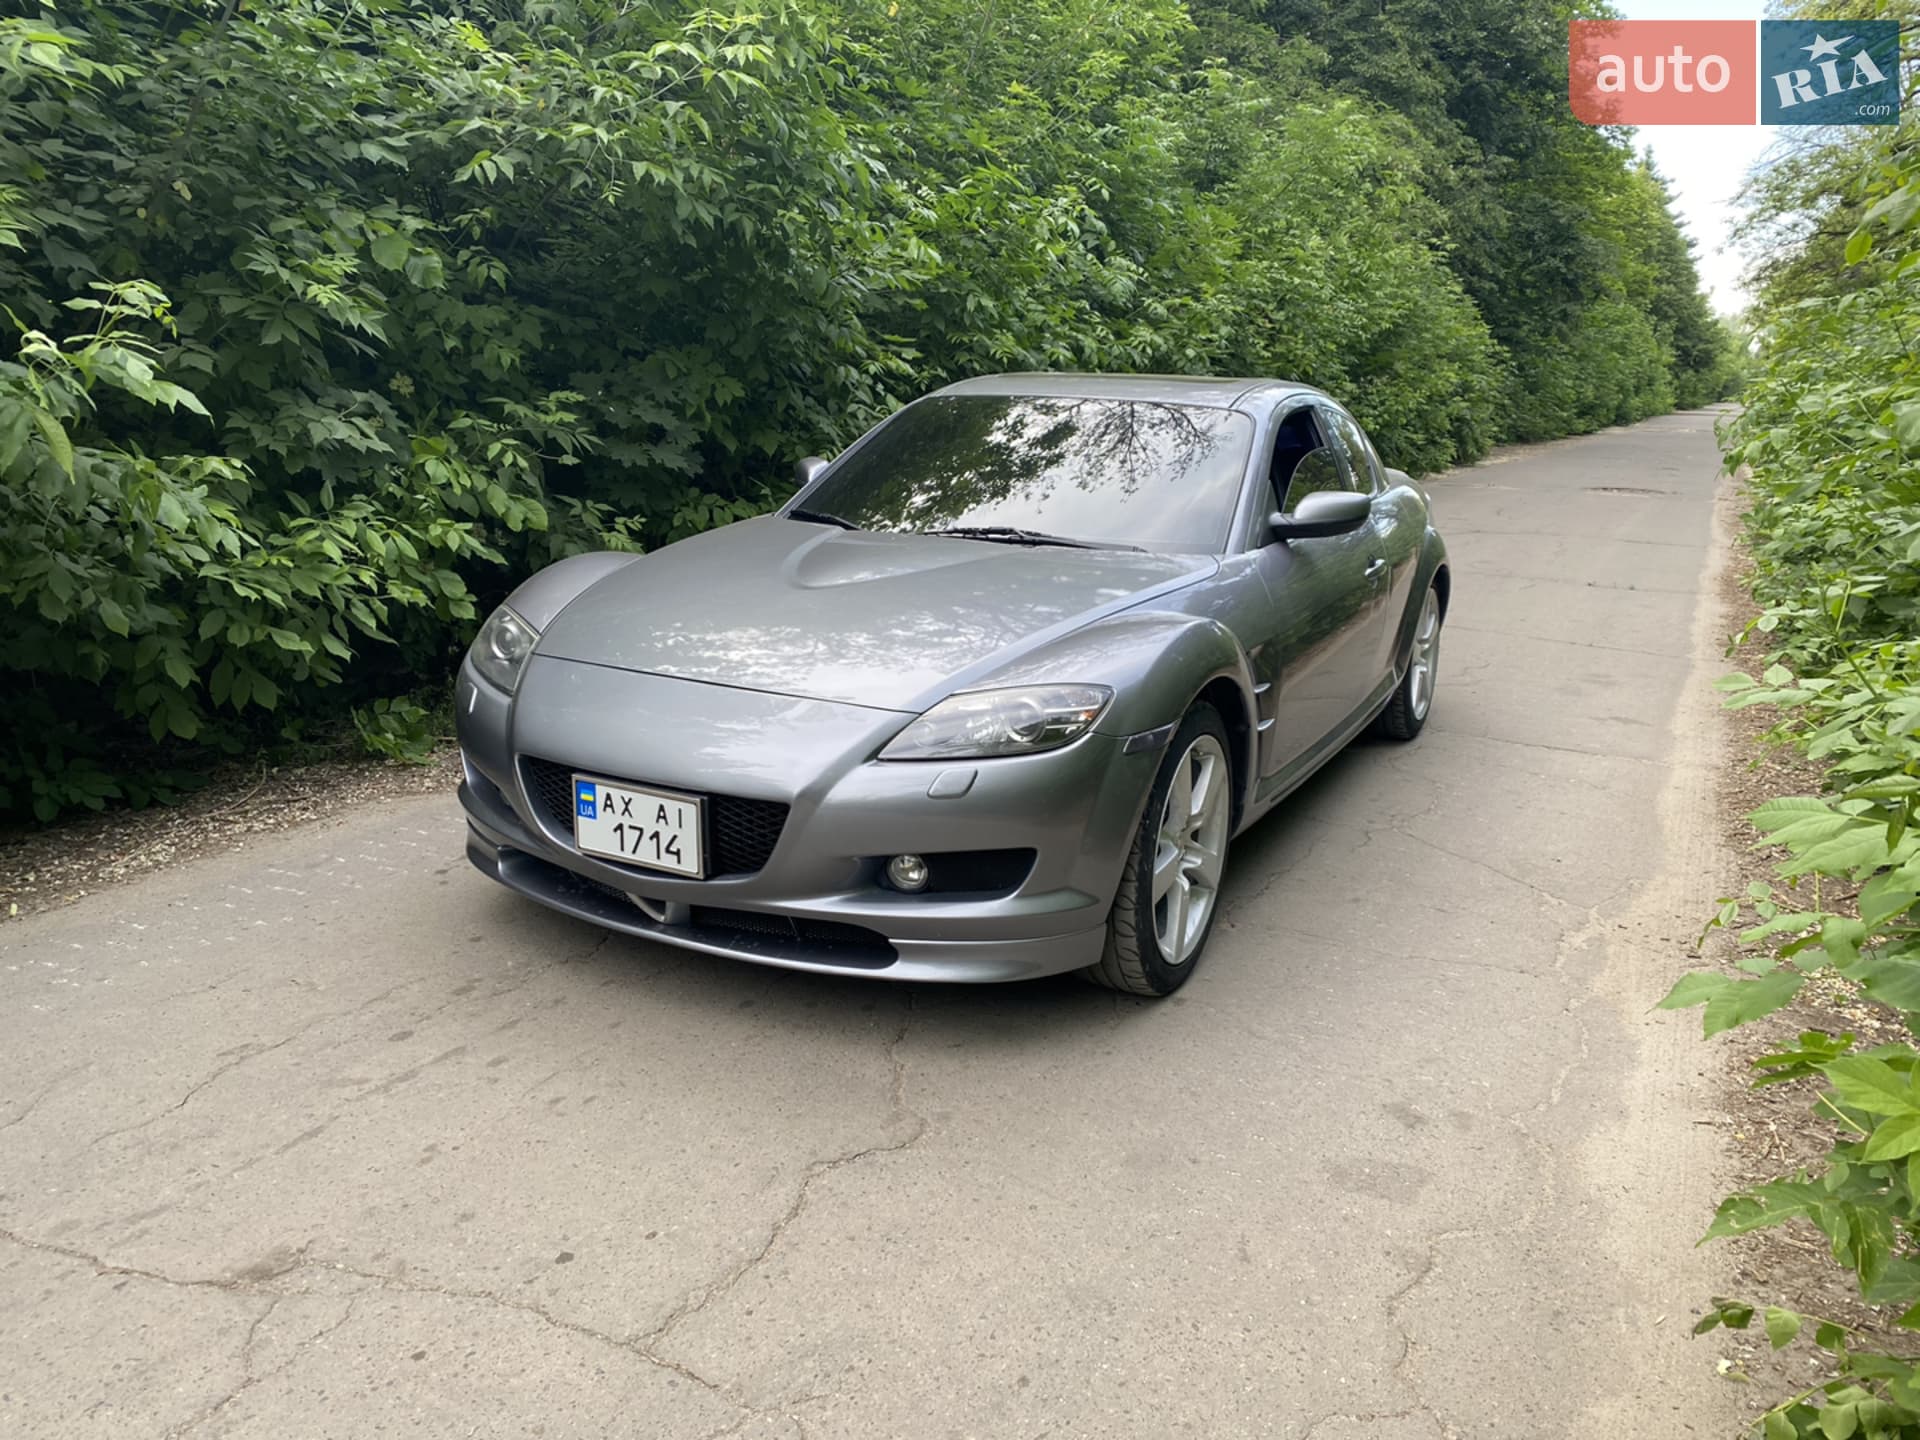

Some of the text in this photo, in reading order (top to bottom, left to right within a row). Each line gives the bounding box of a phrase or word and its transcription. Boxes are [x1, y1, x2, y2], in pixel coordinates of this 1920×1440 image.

[580, 804, 594, 817] UA
[603, 792, 682, 829] AX AI
[613, 822, 681, 865] 1714
